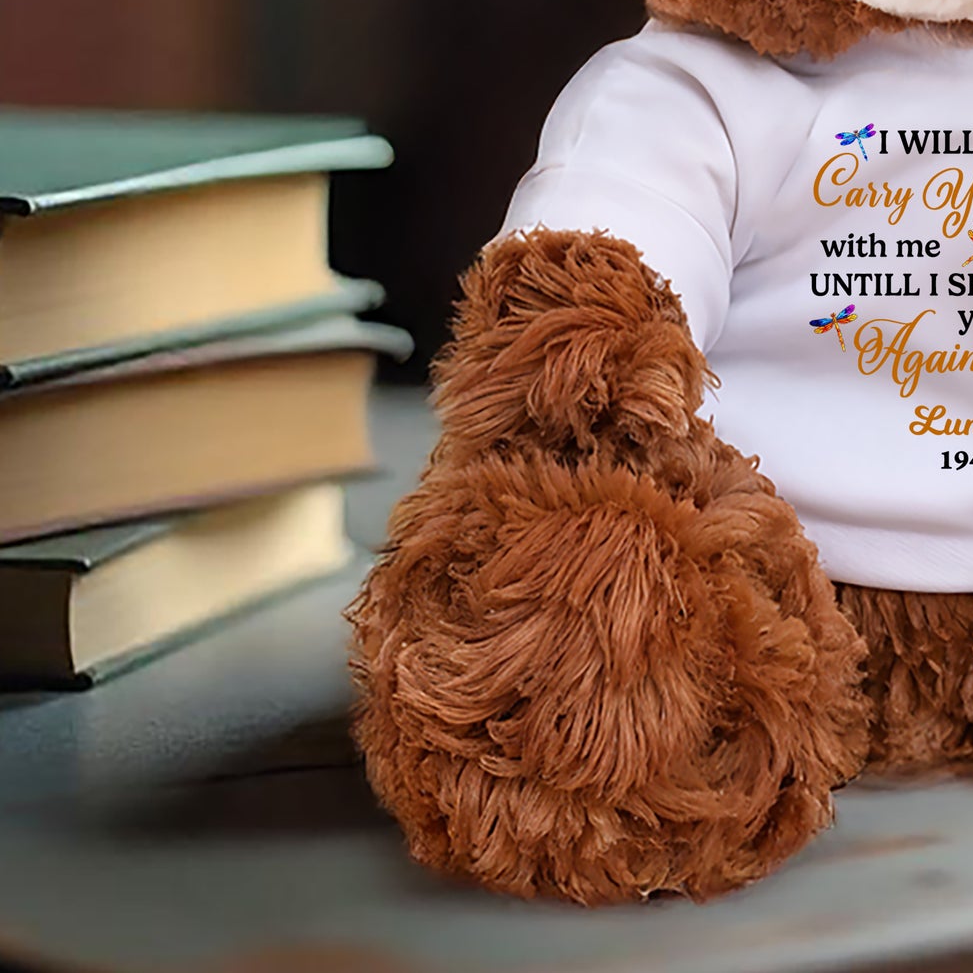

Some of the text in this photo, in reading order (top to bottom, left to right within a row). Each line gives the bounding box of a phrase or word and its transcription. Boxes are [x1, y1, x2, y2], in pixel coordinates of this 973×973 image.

[879, 130, 888, 154] I
[813, 153, 914, 225] Carry
[820, 233, 940, 257] with me
[810, 273, 920, 296] UNTILL
[930, 273, 938, 296] I
